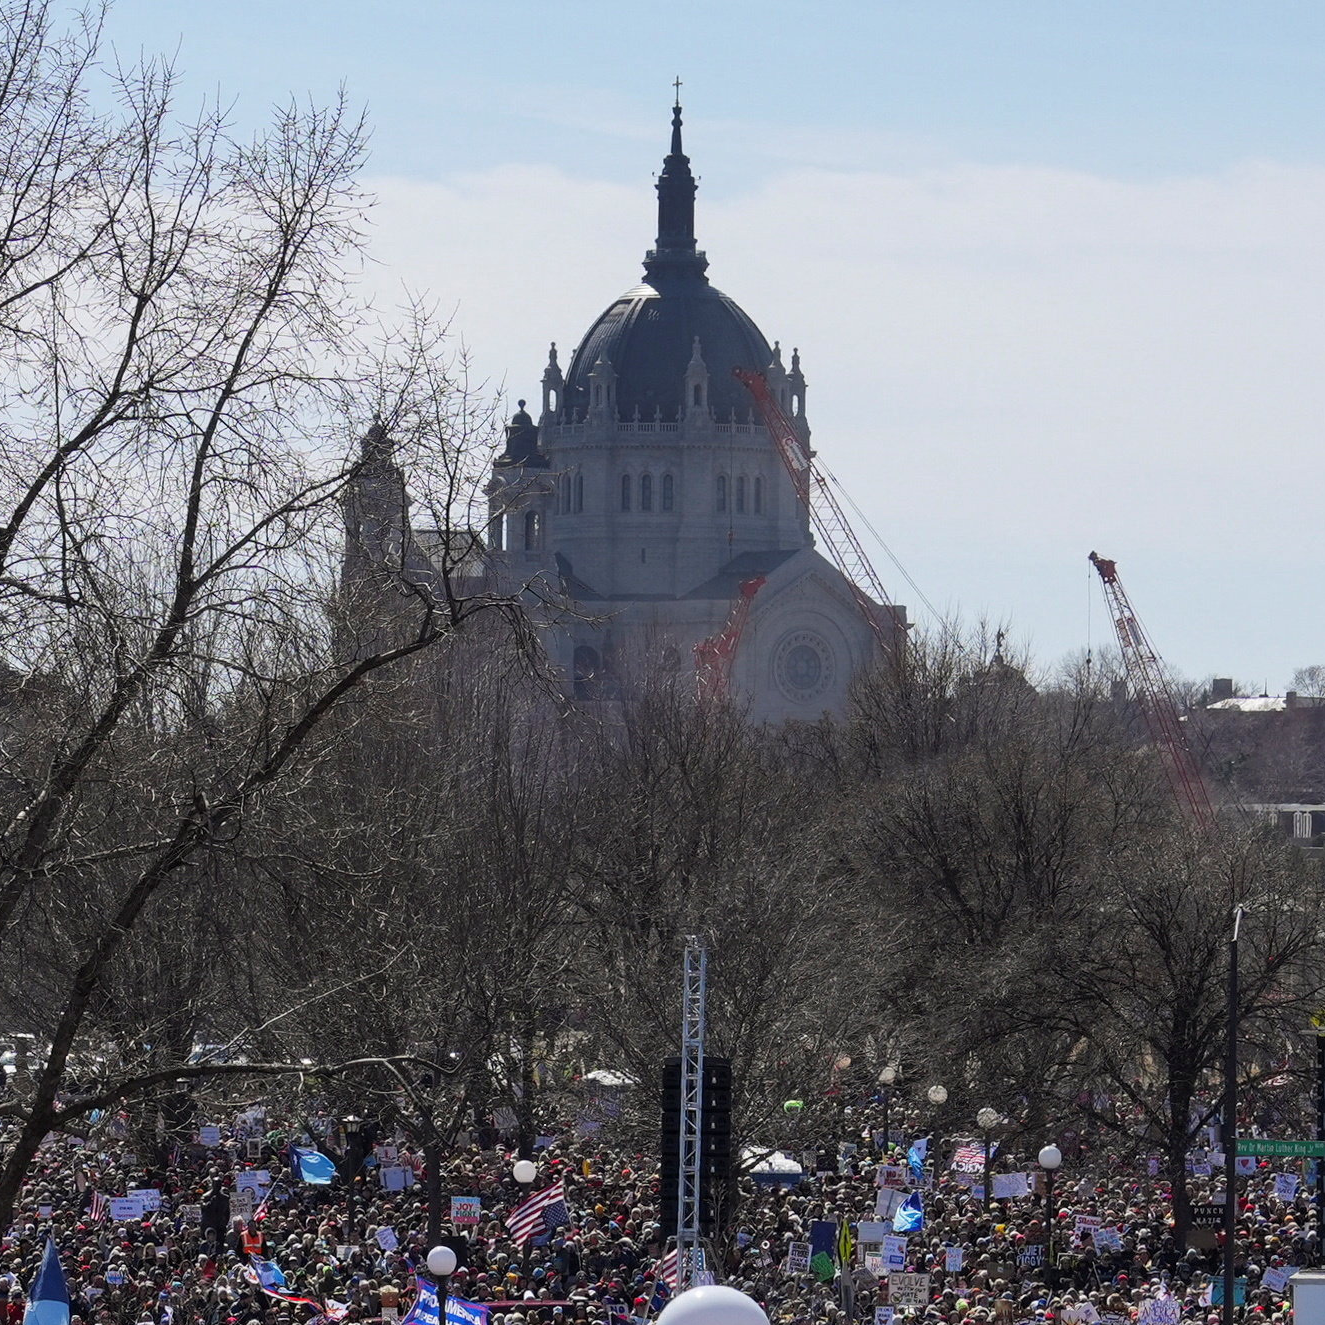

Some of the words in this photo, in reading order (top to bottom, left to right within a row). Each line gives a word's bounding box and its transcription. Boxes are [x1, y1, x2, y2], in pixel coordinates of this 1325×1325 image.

[1237, 1143, 1248, 1152] Rev
[1249, 1143, 1255, 1152] Dr
[1257, 1143, 1275, 1152] Martin
[1275, 1143, 1293, 1153] Luther
[1295, 1144, 1306, 1154] King
[1018, 1245, 1043, 1255] QUIET
[1016, 1256, 1044, 1266] PIGGY
